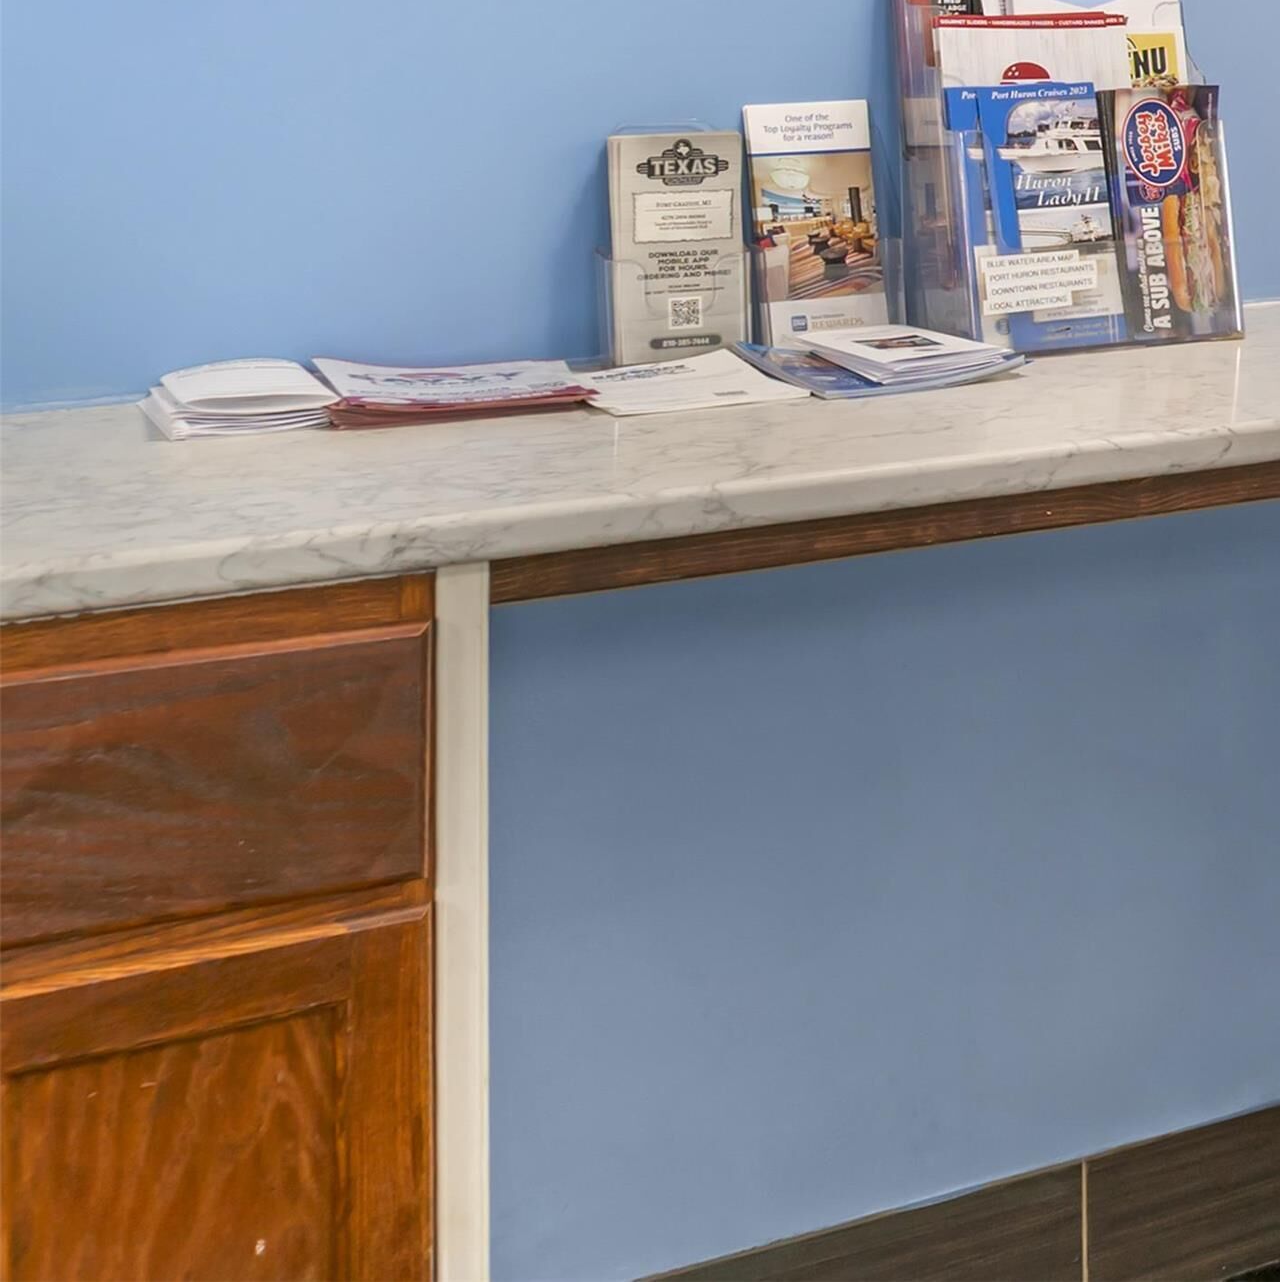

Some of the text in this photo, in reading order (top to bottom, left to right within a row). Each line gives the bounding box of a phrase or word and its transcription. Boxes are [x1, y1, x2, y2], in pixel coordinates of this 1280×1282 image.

[1128, 46, 1167, 79] NU
[991, 86, 1088, 101] Port Huron Cruises 2023
[785, 115, 803, 123] One
[815, 113, 829, 121] the
[763, 122, 853, 134] Top Loyalty Programs
[783, 133, 795, 142] for
[1135, 112, 1160, 177] Jersey
[1153, 109, 1177, 169] Mike's
[1170, 126, 1182, 152] SUBS
[650, 158, 717, 176] TEXAS
[1015, 174, 1072, 191] Huron
[1036, 187, 1082, 207] Lady
[1141, 206, 1165, 267] ABOVE
[648, 250, 698, 259] DOWNLOAD
[986, 253, 1074, 268] BLUE WATER AREA MAP
[637, 272, 681, 281] ORDERING
[989, 263, 1095, 282] PORT HURON RESTAURANTS
[991, 277, 1093, 296] DOWNTOWN RESTAURANTS
[1138, 274, 1150, 295] what
[1149, 273, 1170, 310] SUB
[989, 301, 1013, 310] LOCAL
[1015, 296, 1068, 307] ATTRACTIONS
[811, 317, 865, 330] REWARDS
[1141, 309, 1154, 332] Come
[1154, 315, 1172, 329] A
